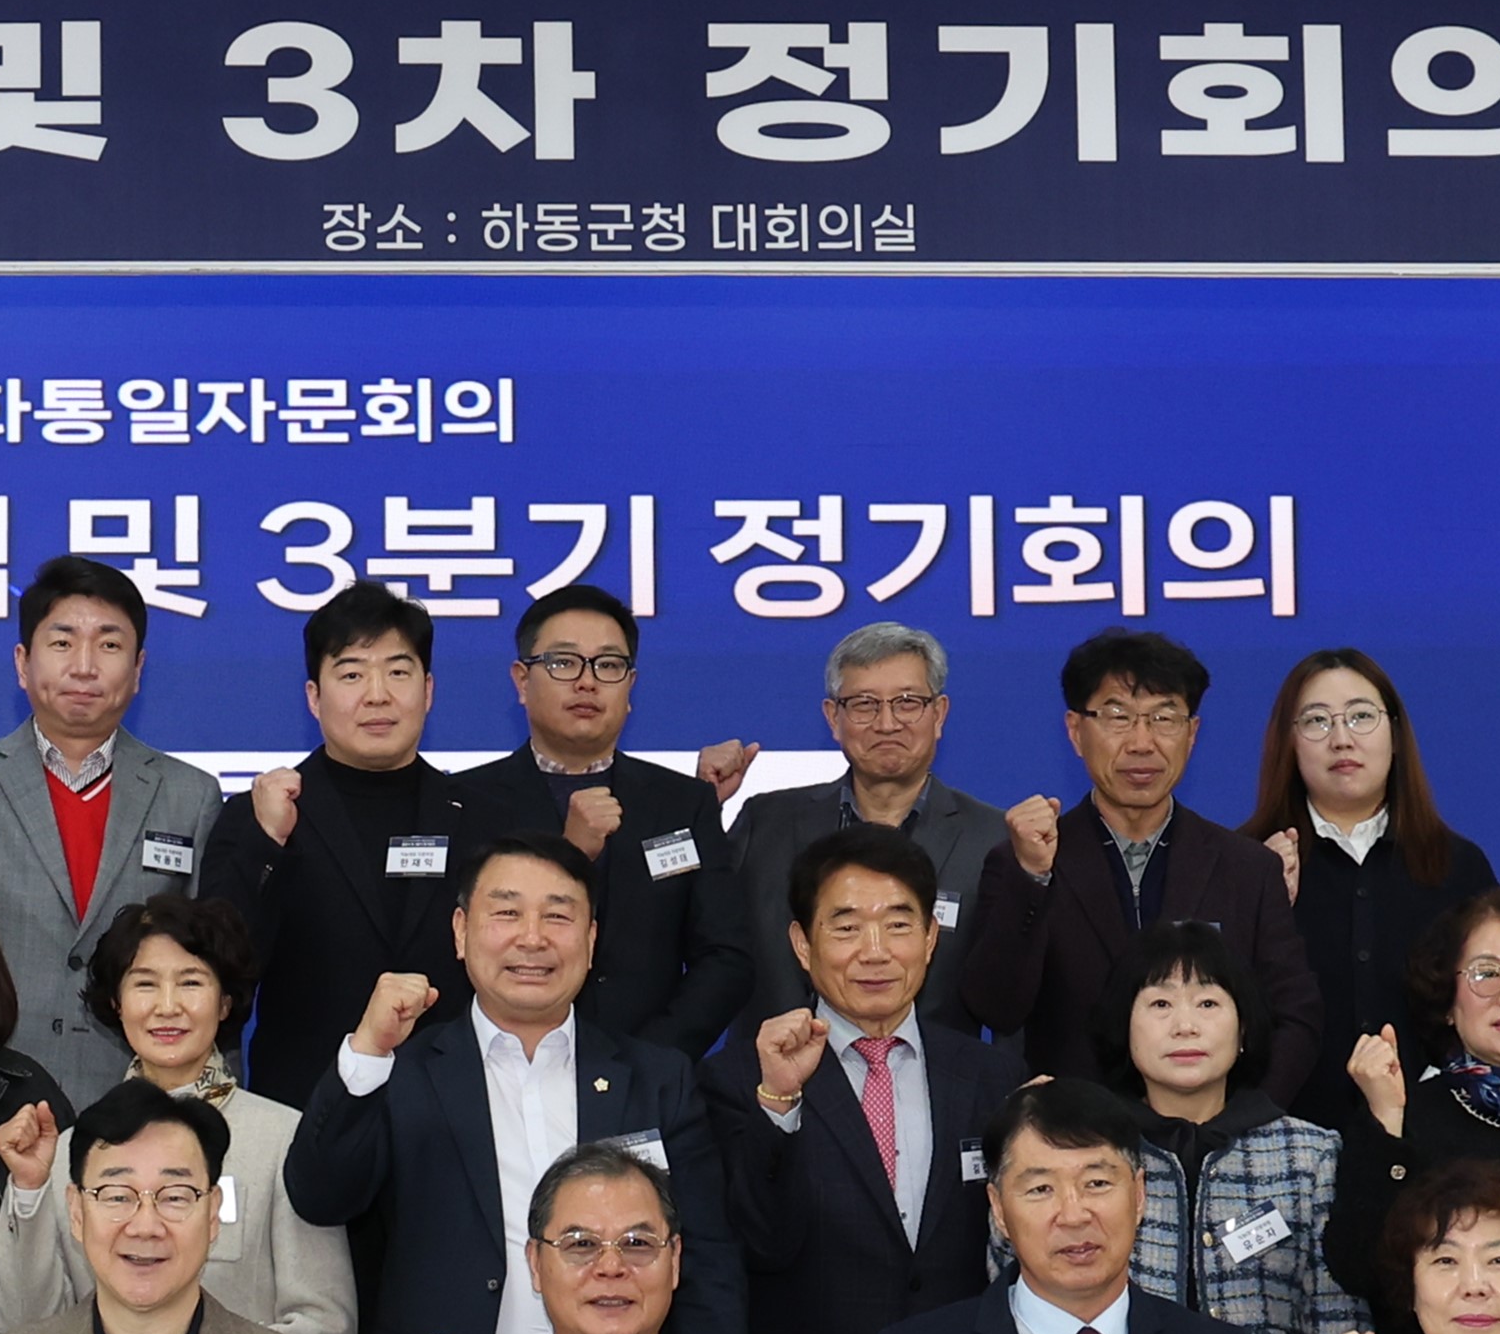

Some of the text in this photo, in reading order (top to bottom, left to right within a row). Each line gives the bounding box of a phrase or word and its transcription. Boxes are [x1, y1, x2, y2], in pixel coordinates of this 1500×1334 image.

[221, 20, 598, 163] 3차
[322, 203, 426, 253] 장소
[481, 202, 688, 253] 하동군청
[712, 202, 918, 253] 대회의실
[68, 494, 208, 618] 및
[255, 495, 656, 617] 3분기
[709, 494, 1298, 619] 정기회의
